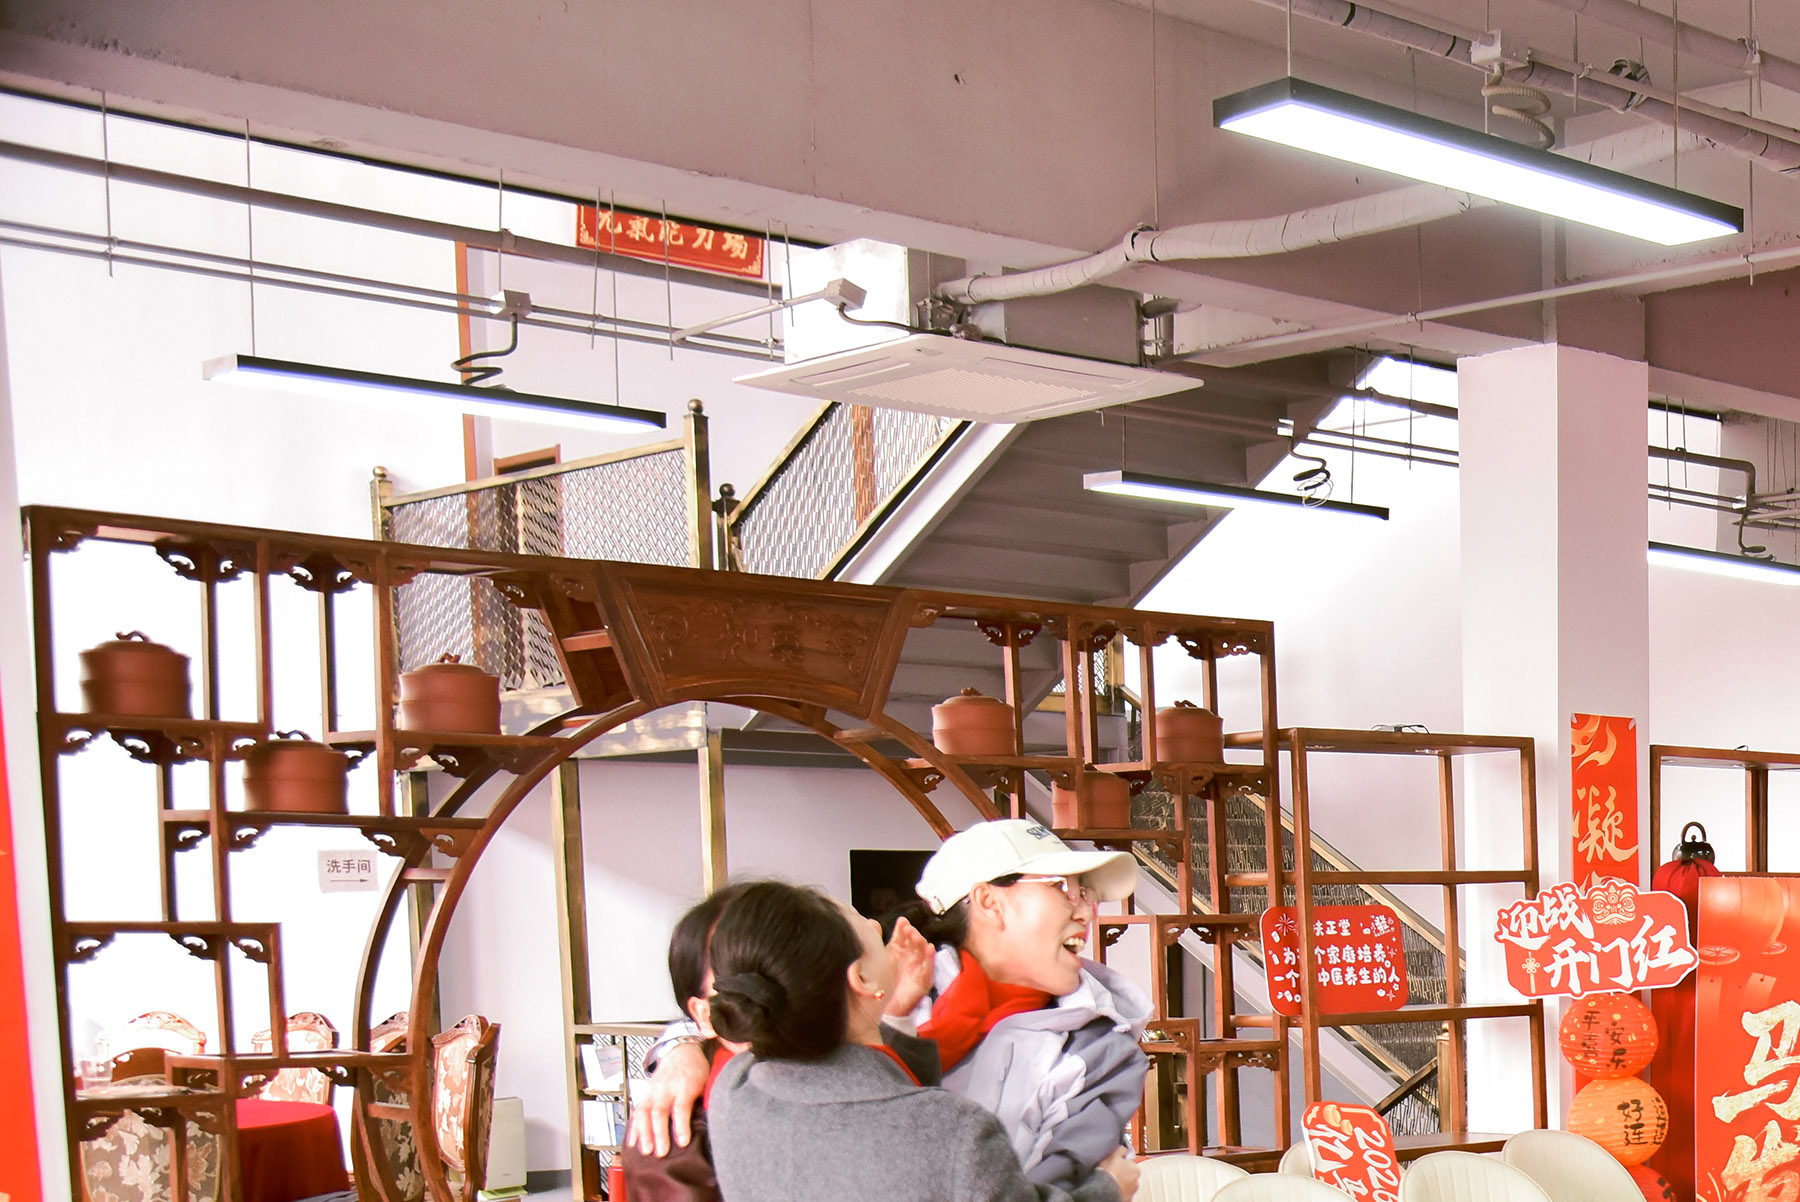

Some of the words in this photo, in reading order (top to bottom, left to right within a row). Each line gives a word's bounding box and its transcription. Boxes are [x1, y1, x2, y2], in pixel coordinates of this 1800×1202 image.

[1572, 785, 1639, 897] 凝
[327, 860, 371, 873] 洗手间
[1498, 886, 1595, 950] 迎战
[1284, 943, 1387, 965] 为个家庭培养
[1544, 916, 1695, 994] 开门红
[1274, 966, 1400, 988] 一个中医养生的人
